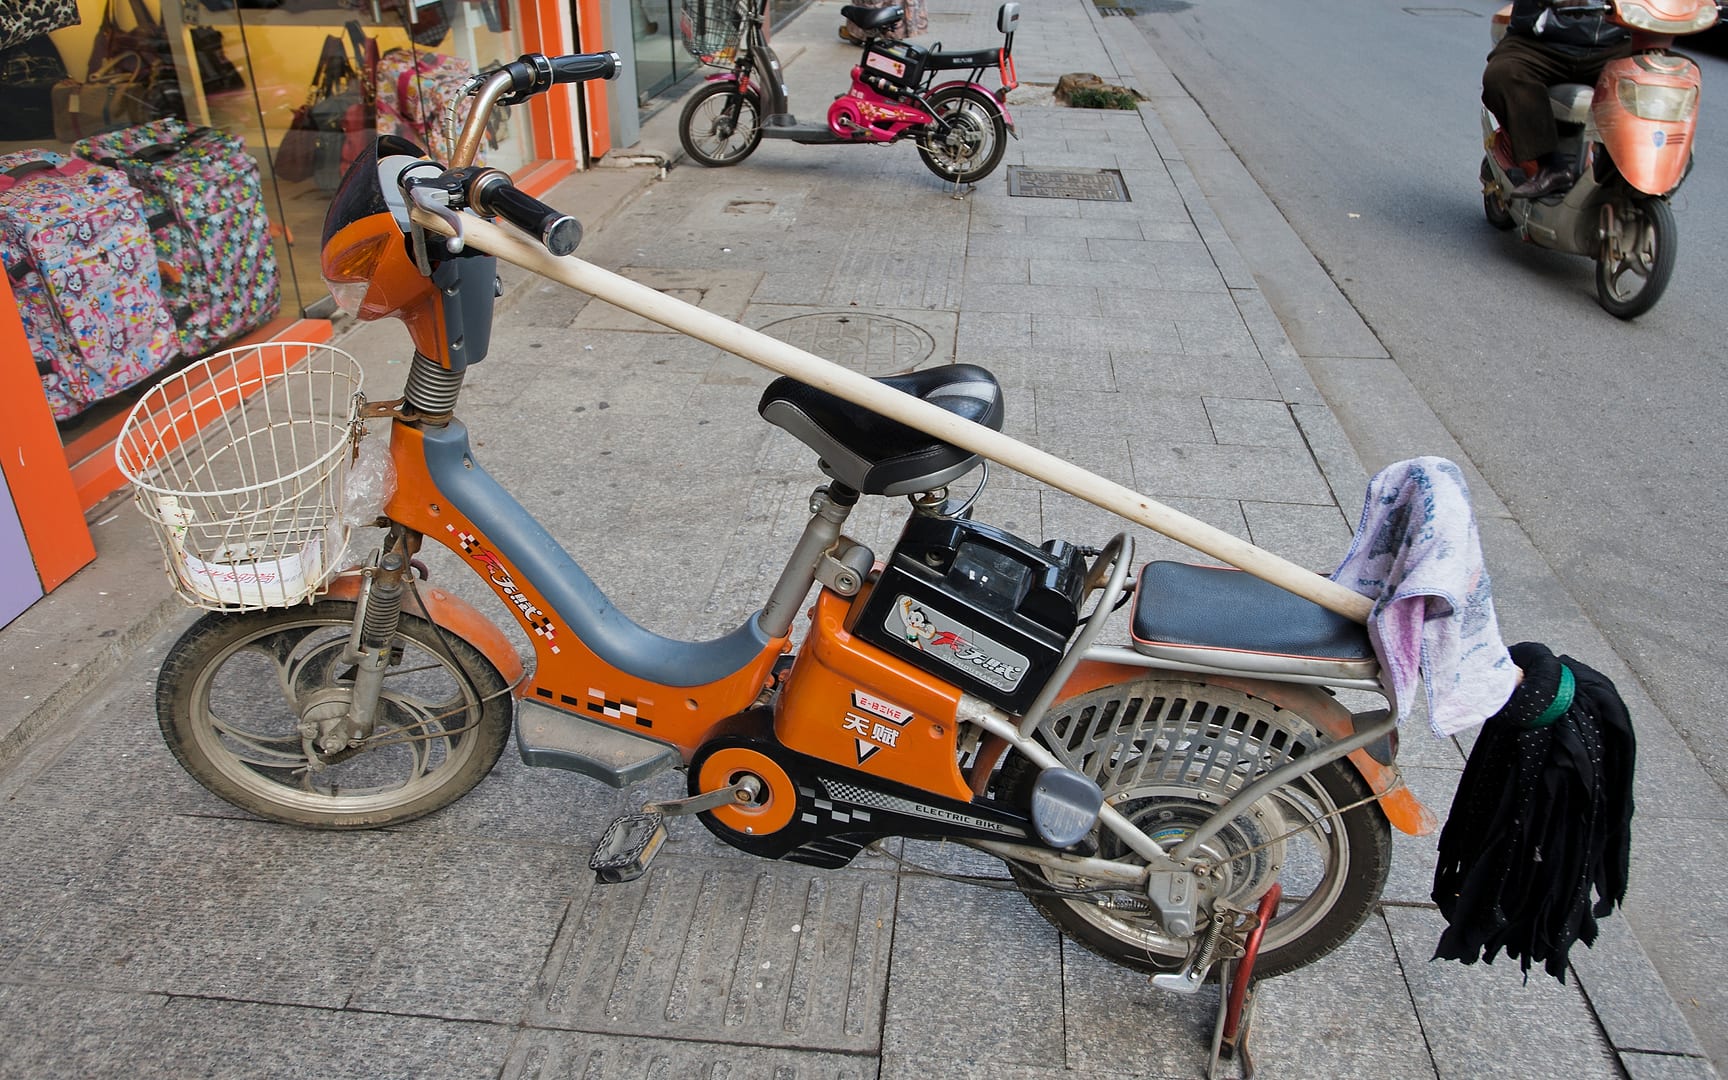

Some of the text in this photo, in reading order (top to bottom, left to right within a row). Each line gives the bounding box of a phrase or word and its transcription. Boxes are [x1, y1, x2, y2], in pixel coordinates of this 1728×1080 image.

[860, 697, 902, 720] E-BIKE
[842, 711, 900, 748] 天赋
[915, 804, 1005, 831] ELECTRIC BIKE
